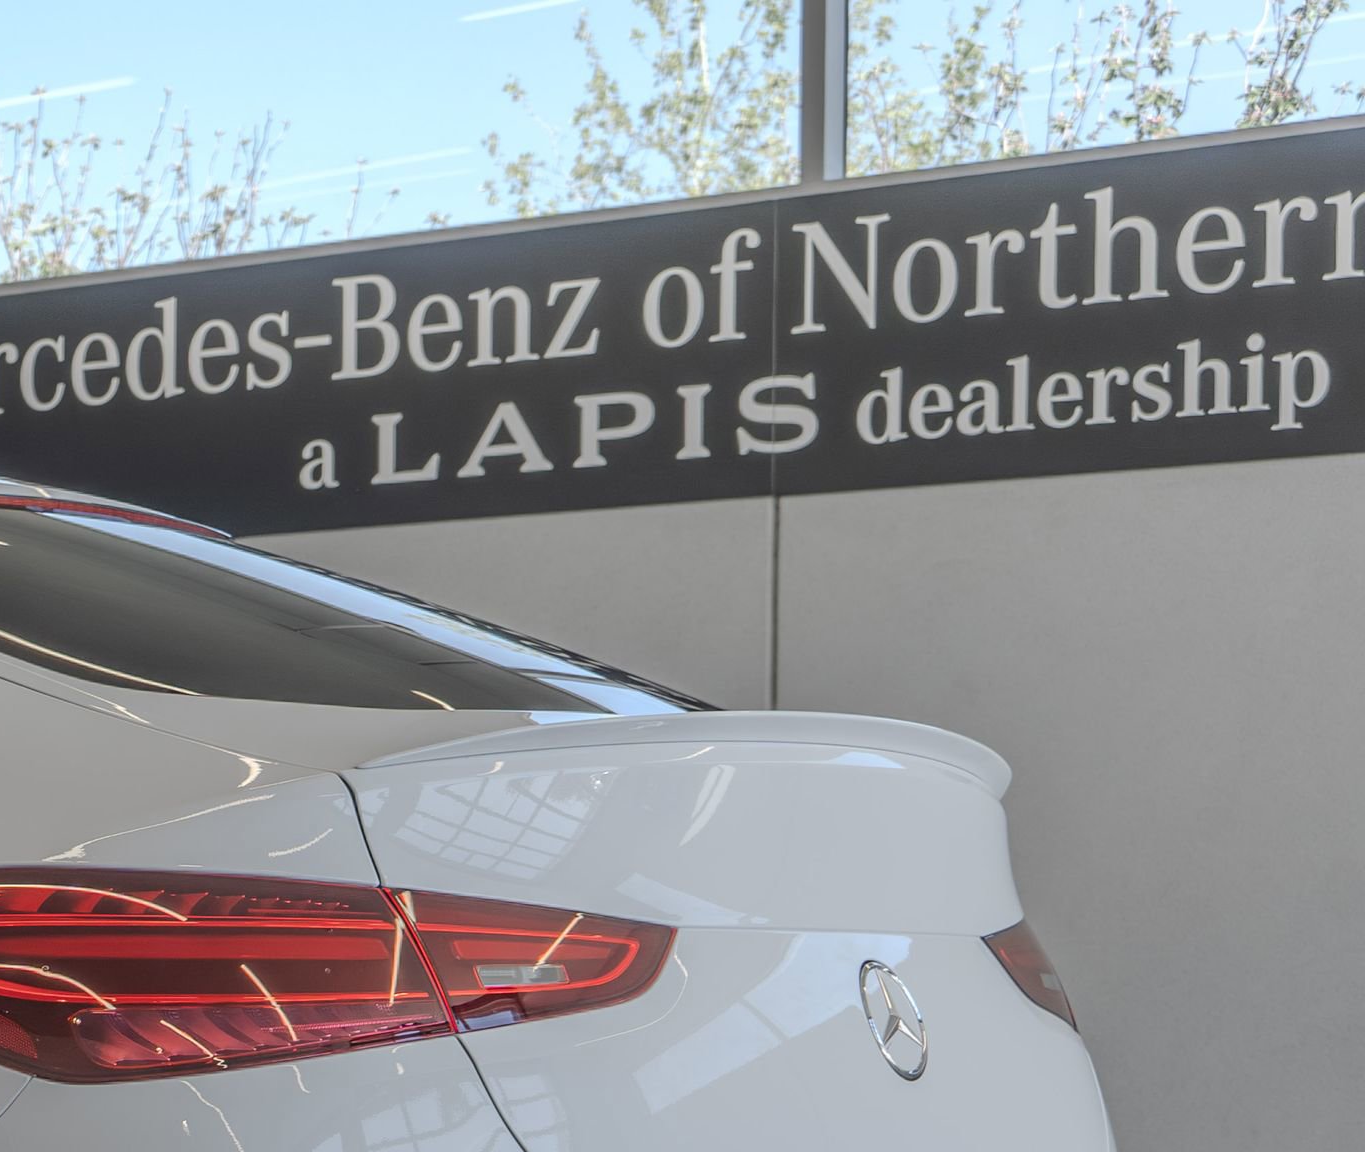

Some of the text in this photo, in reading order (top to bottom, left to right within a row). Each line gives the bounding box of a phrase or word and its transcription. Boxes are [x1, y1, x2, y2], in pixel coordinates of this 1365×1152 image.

[642, 227, 761, 349] of
[298, 332, 1331, 490] a LAPIS dealership
